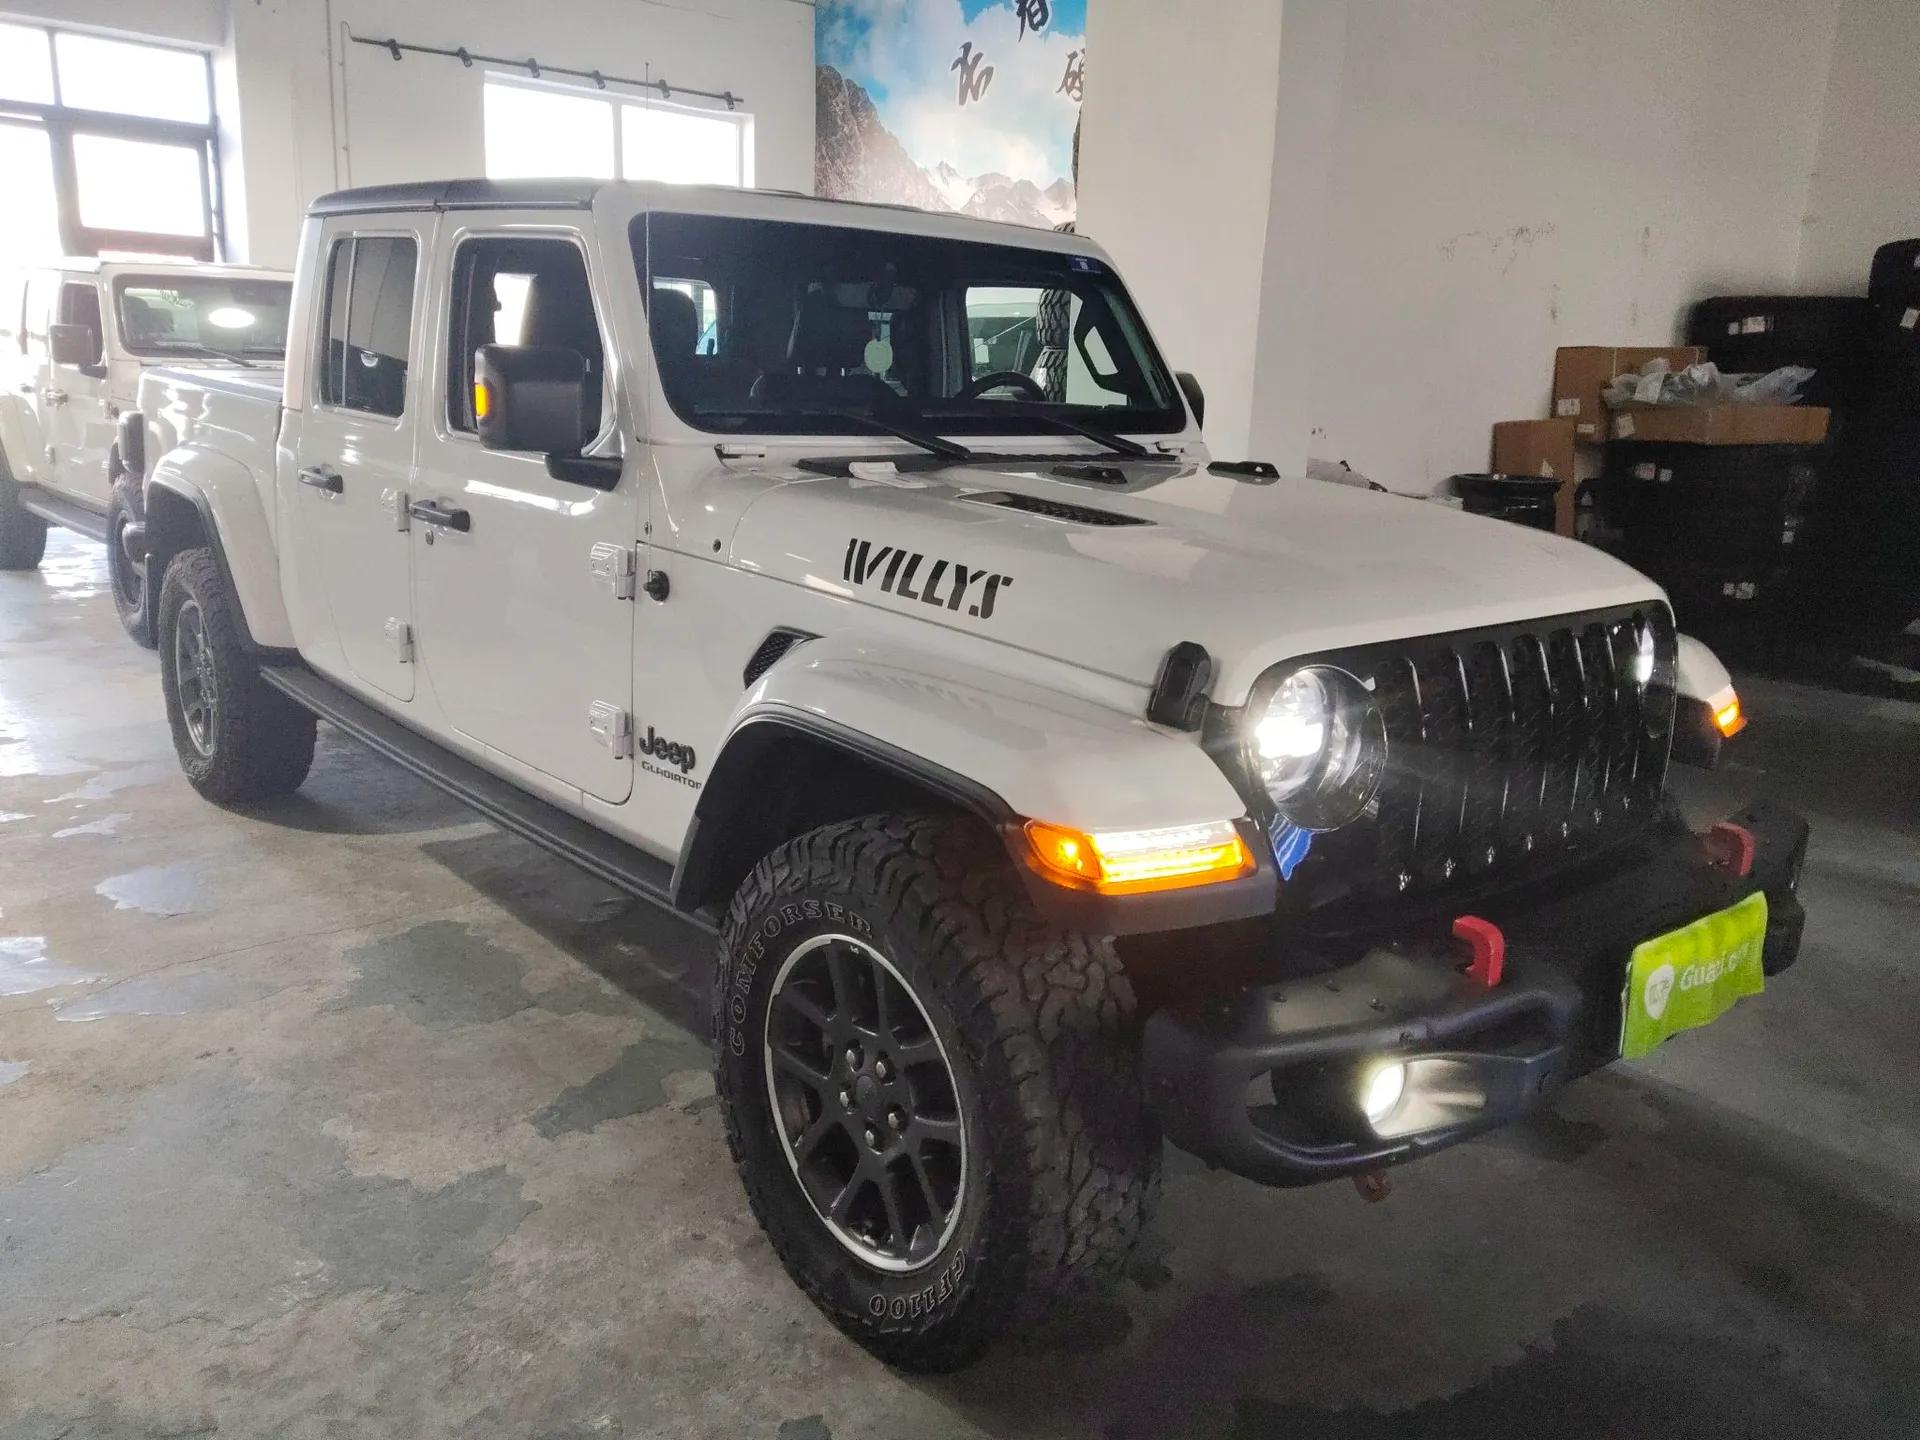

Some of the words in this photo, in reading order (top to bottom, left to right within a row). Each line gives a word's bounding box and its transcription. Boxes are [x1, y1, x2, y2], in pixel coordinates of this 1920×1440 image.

[843, 538, 1014, 619] WILLYS
[639, 725, 696, 774] Jeep
[641, 760, 702, 790] GLADIATOR
[729, 900, 873, 1056] COMFORSER
[868, 1248, 966, 1319] CF1100
